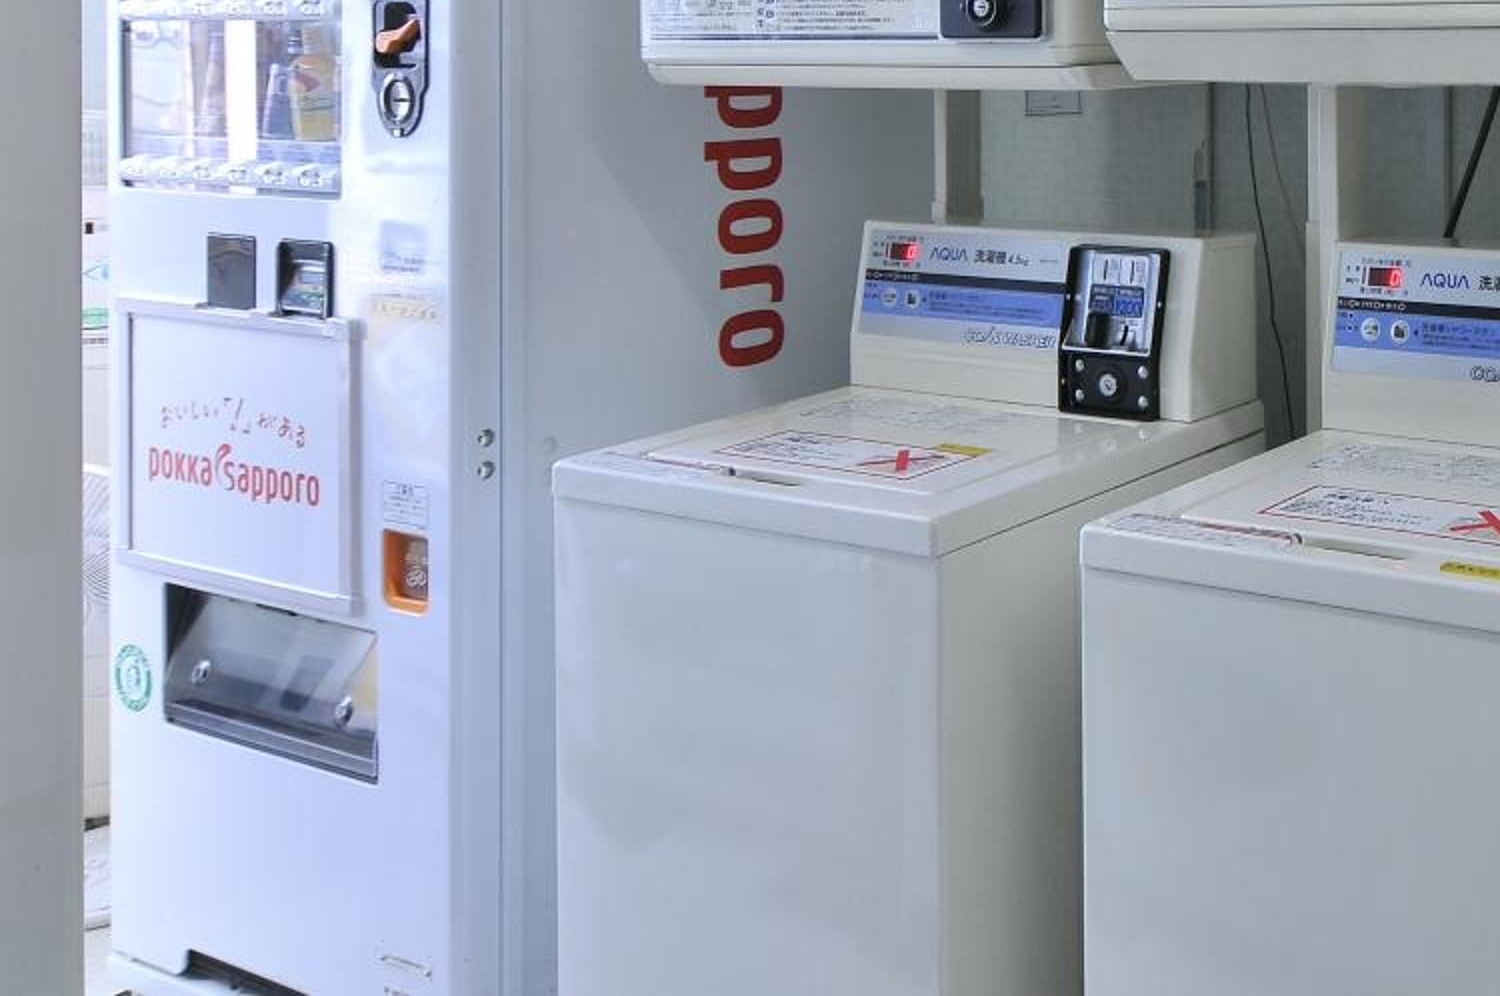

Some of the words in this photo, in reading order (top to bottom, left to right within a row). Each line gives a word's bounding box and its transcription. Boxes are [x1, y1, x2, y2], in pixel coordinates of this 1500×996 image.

[929, 246, 969, 262] AQUA
[1388, 269, 1402, 287] 0
[1419, 272, 1470, 290] AQUA
[224, 460, 320, 507] sapporo
